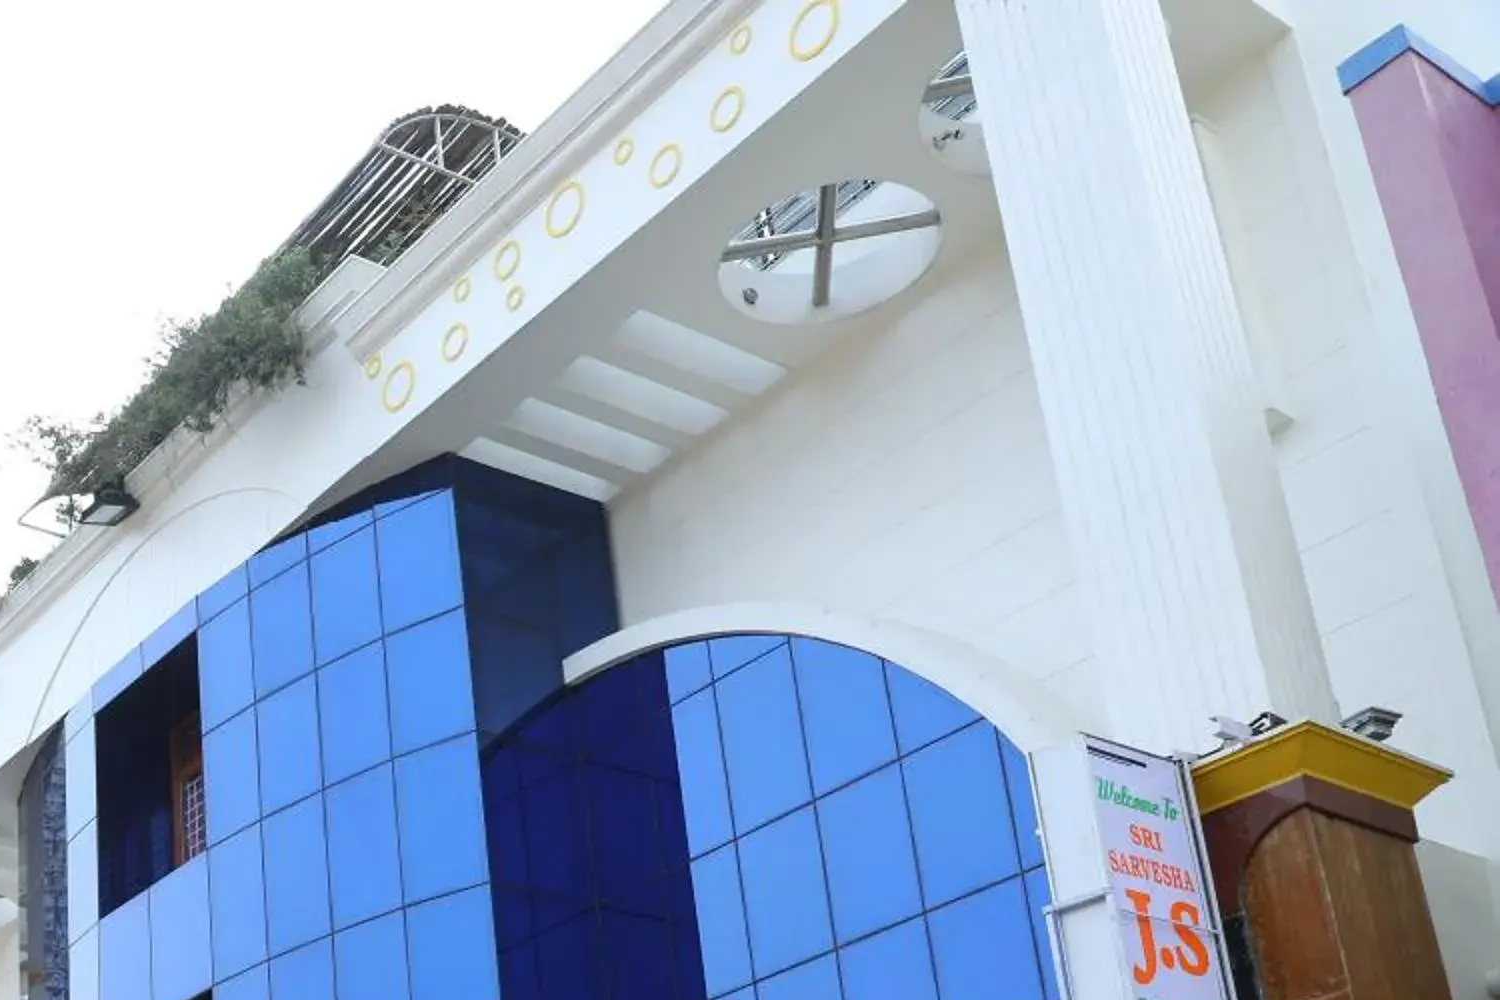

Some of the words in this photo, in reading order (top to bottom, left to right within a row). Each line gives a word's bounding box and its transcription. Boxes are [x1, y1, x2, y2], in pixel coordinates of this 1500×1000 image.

[1129, 823, 1163, 852] SRI
[1108, 849, 1196, 892] SARVESHA
[1125, 888, 1210, 985] J.S
